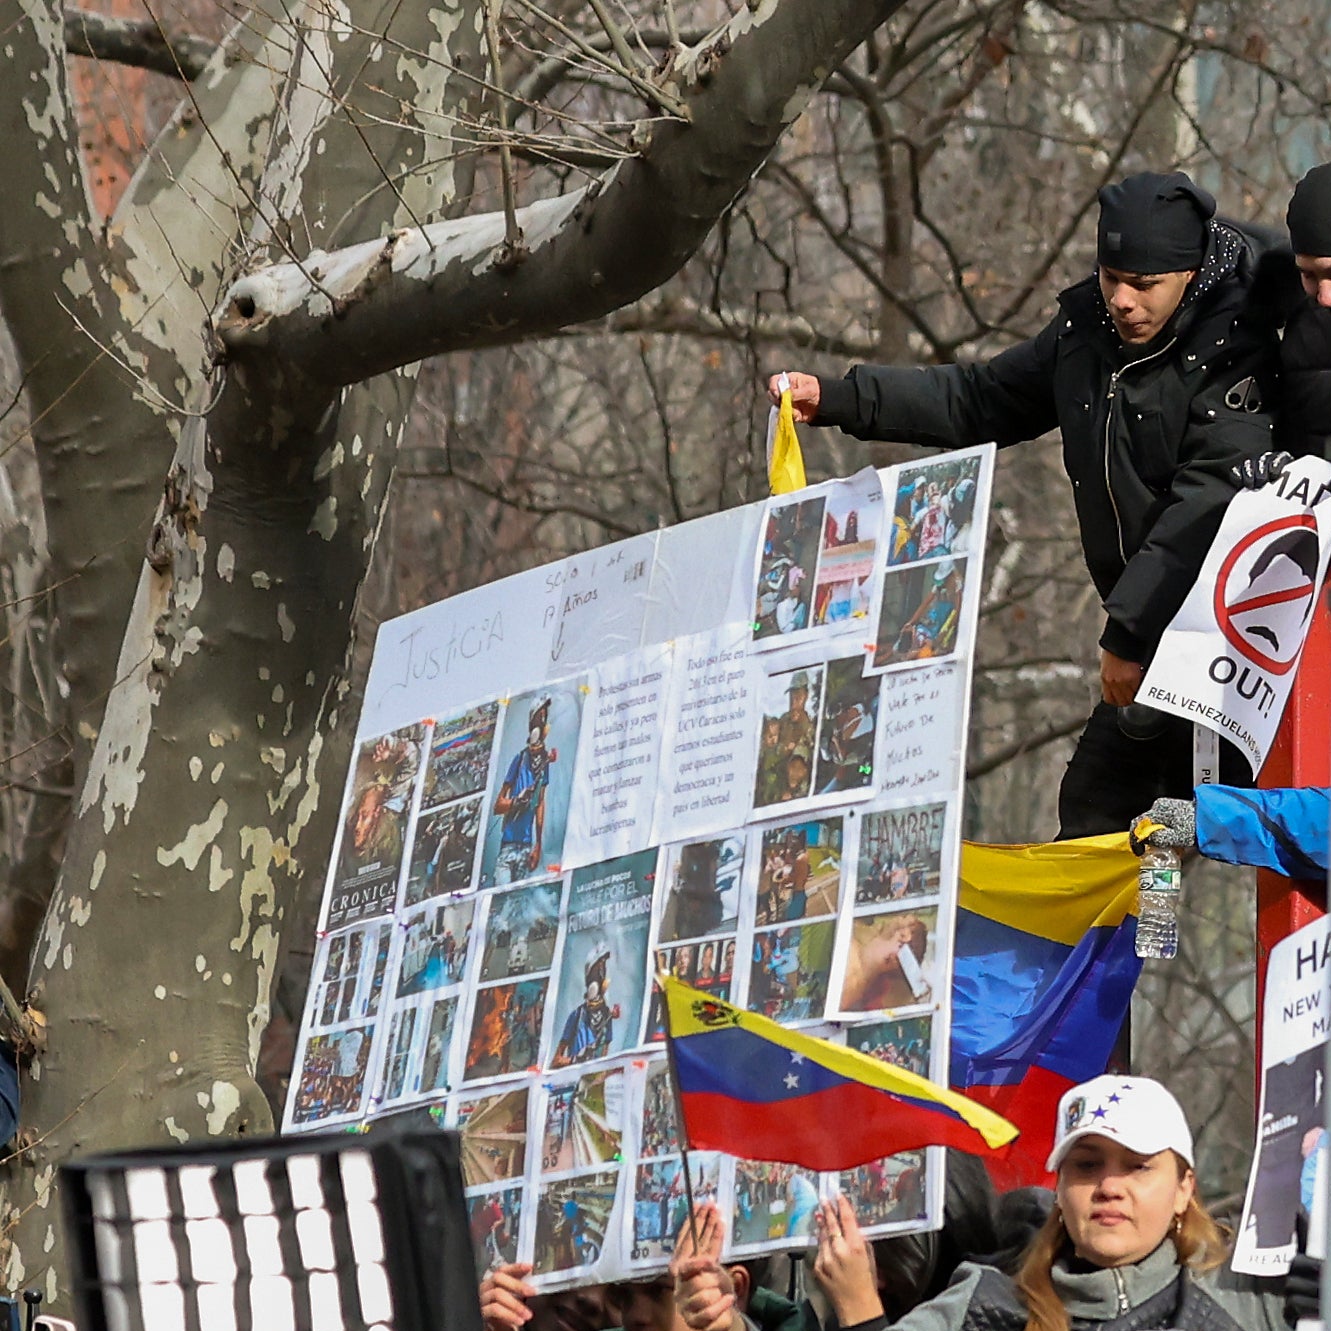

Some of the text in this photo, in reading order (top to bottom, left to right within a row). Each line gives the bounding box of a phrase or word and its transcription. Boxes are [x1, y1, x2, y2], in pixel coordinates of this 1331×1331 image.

[1208, 655, 1276, 720] OUT!
[1148, 686, 1256, 752] REAL VENEZUELANS
[331, 880, 396, 912] CRONICA
[1283, 990, 1321, 1023] NEW
